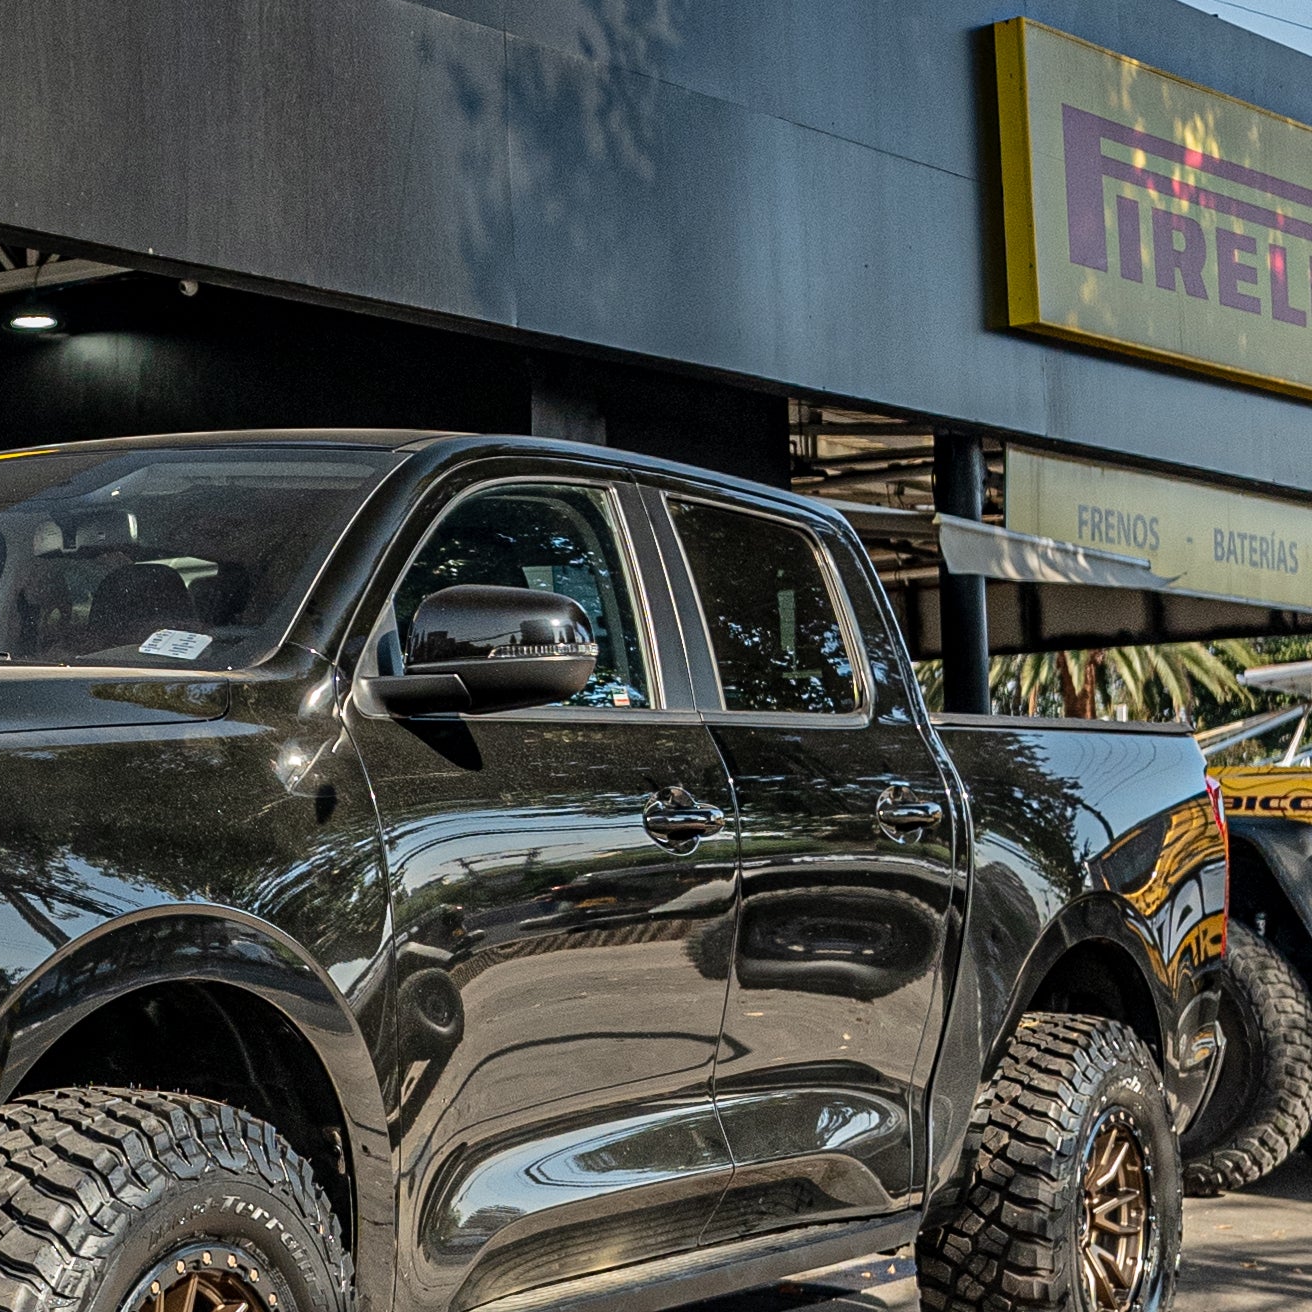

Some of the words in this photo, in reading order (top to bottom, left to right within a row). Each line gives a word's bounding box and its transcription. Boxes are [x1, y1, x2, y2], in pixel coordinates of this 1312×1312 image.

[1061, 102, 1312, 328] PIREL
[1077, 504, 1160, 552] FRENOS
[1213, 527, 1299, 575] BATERÍAS
